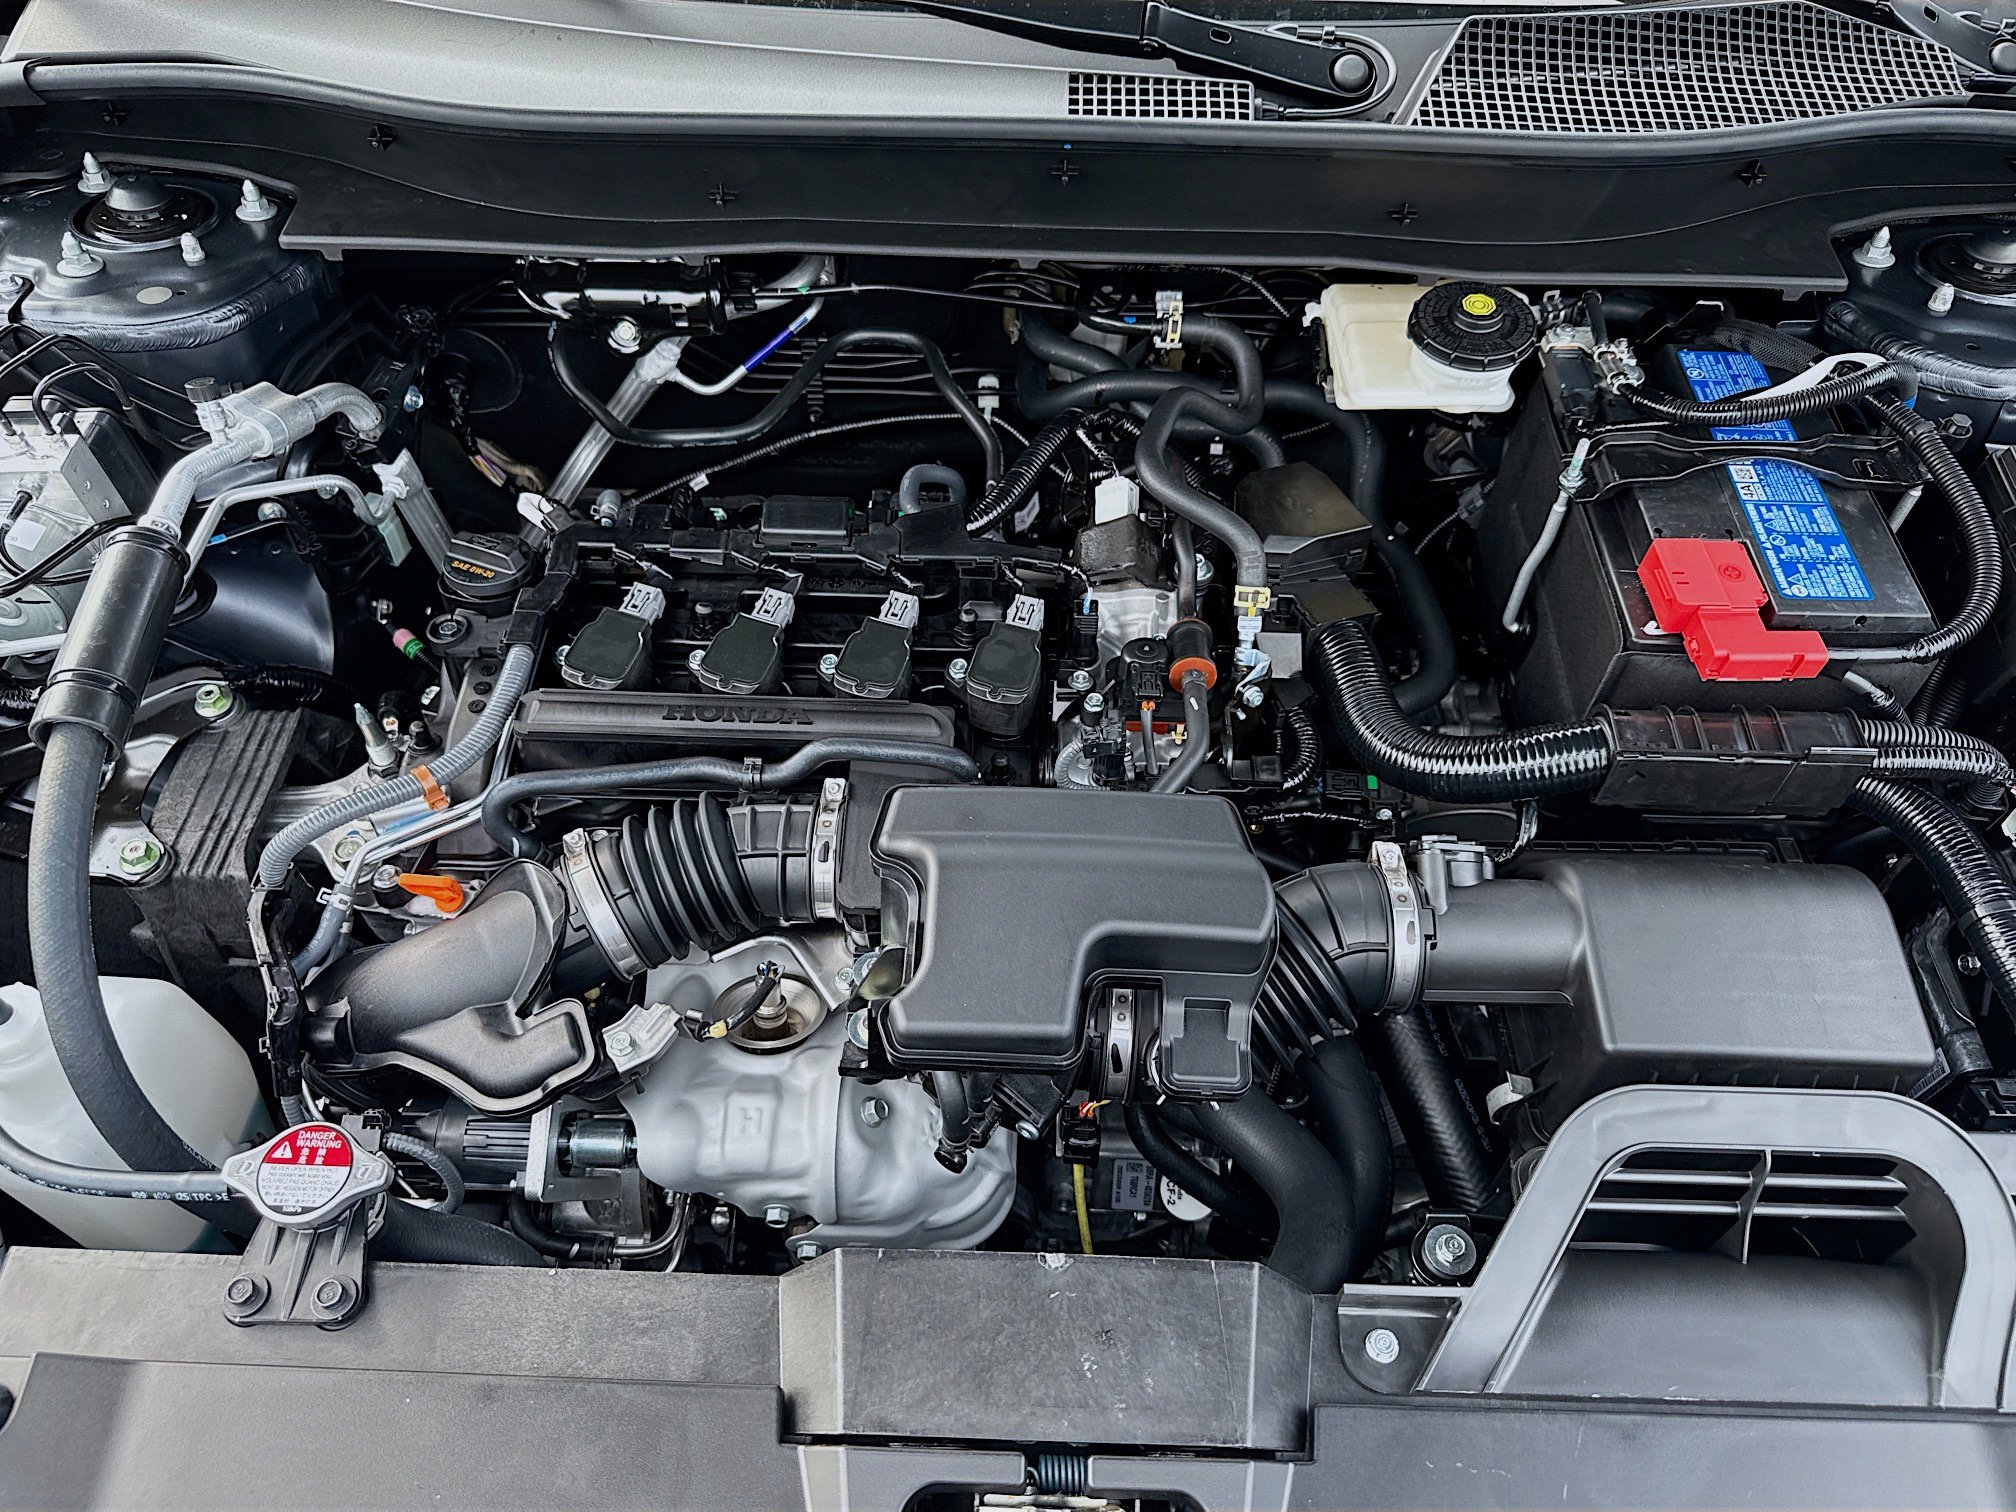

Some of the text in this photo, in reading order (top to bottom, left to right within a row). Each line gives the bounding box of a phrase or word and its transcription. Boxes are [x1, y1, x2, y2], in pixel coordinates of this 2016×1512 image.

[1740, 484, 1755, 499] 4A
[451, 560, 495, 578] SAE 0W-20
[662, 704, 814, 726] HONDA
[298, 1130, 336, 1141] DANGER
[296, 1138, 342, 1149] WARNUNG
